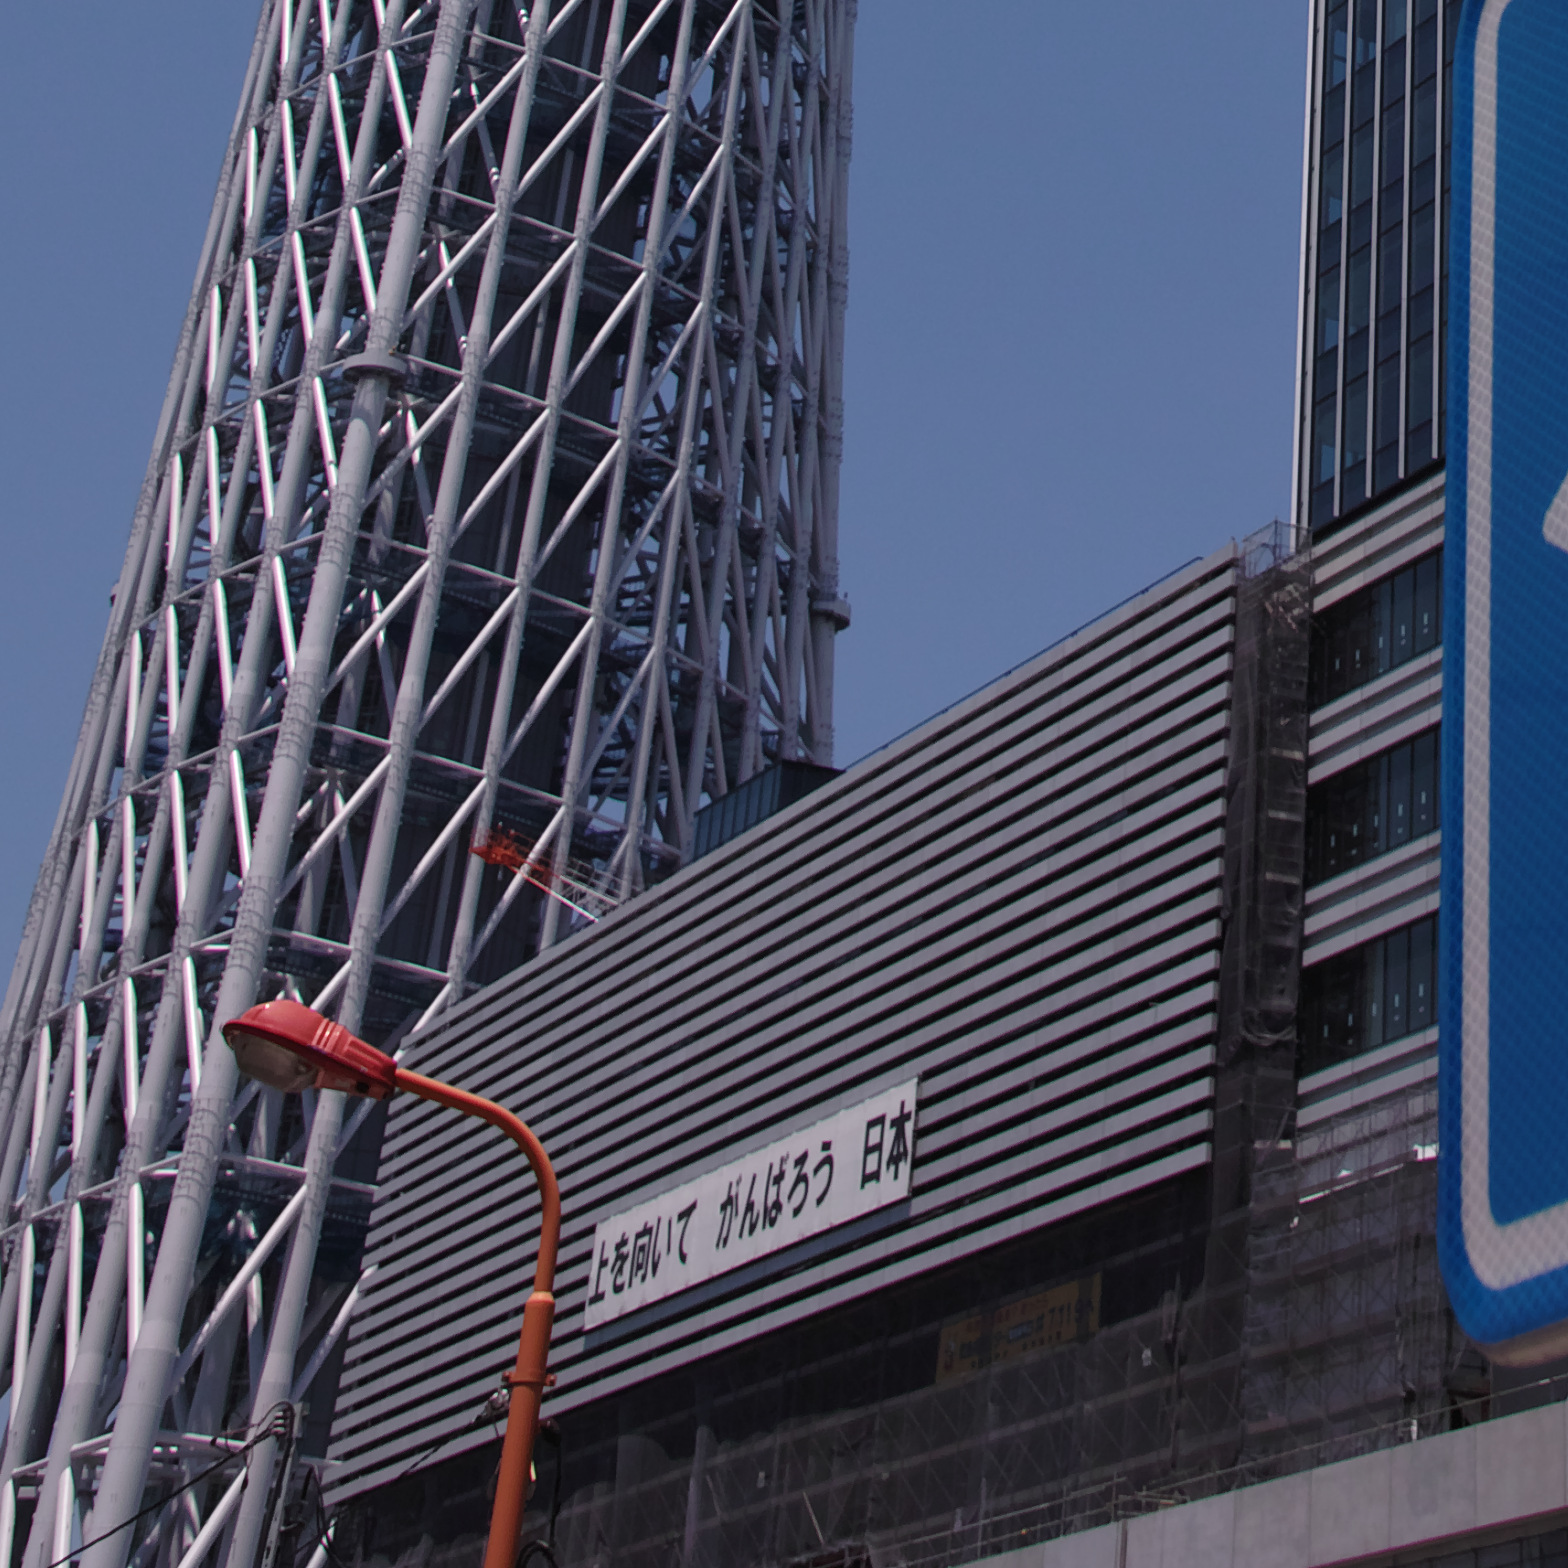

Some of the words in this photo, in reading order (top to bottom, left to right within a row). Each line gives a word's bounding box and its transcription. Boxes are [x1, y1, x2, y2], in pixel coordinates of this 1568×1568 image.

[588, 1199, 698, 1306] 上を向いて
[715, 1141, 835, 1251] がんばろう
[860, 1100, 913, 1190] 日本
